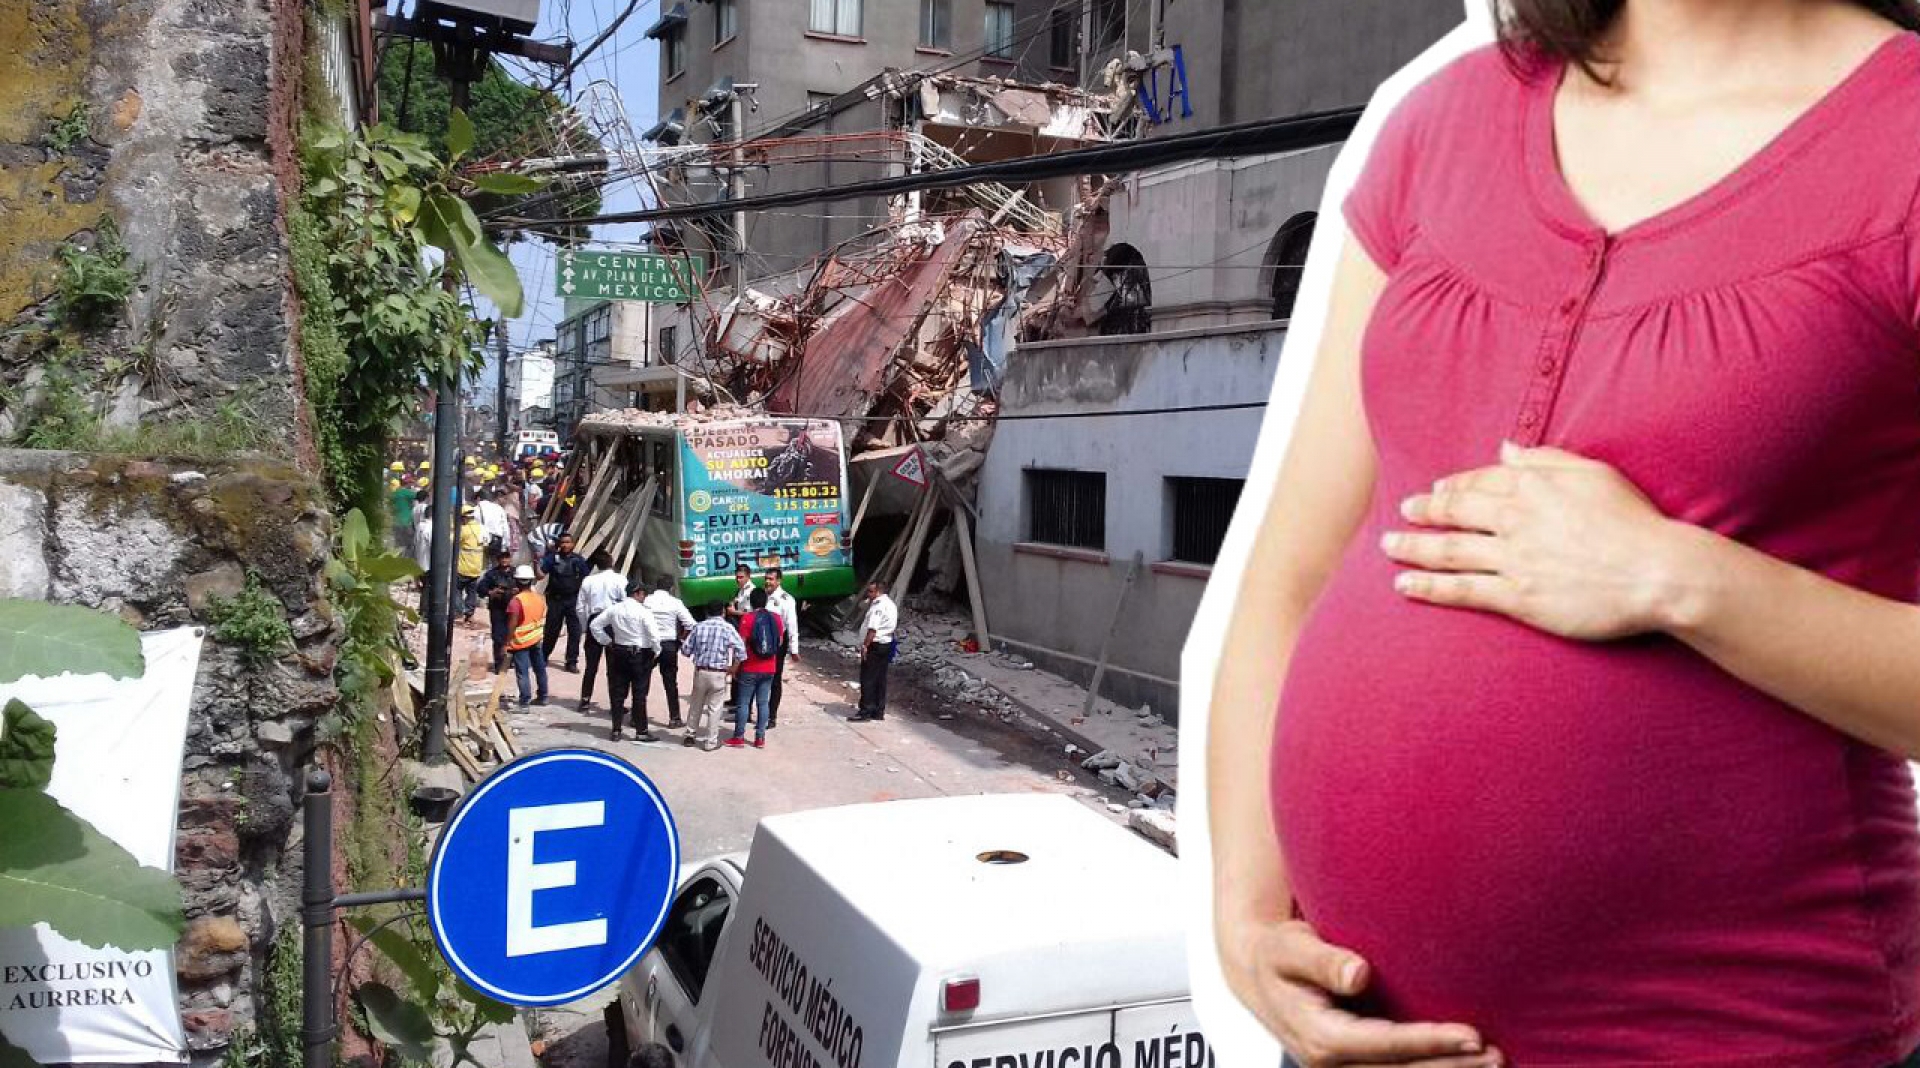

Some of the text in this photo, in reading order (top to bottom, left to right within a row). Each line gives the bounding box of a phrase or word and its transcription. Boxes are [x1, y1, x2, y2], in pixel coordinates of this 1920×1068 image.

[597, 256, 680, 270] CENTRO
[607, 270, 635, 283] PLAN
[641, 272, 655, 284] DE
[599, 284, 678, 298] MEXICO
[694, 435, 760, 448] PASADO
[707, 457, 768, 470] SU AUTO
[709, 513, 762, 527] EVITA
[711, 528, 800, 544] CONTROLA
[507, 800, 608, 957] E
[4, 960, 153, 983] EXCLUSIVO
[9, 987, 136, 1010] AURRERA
[749, 916, 864, 1068] SERVICIO MÉDICO
[759, 1001, 821, 1068] FOREN
